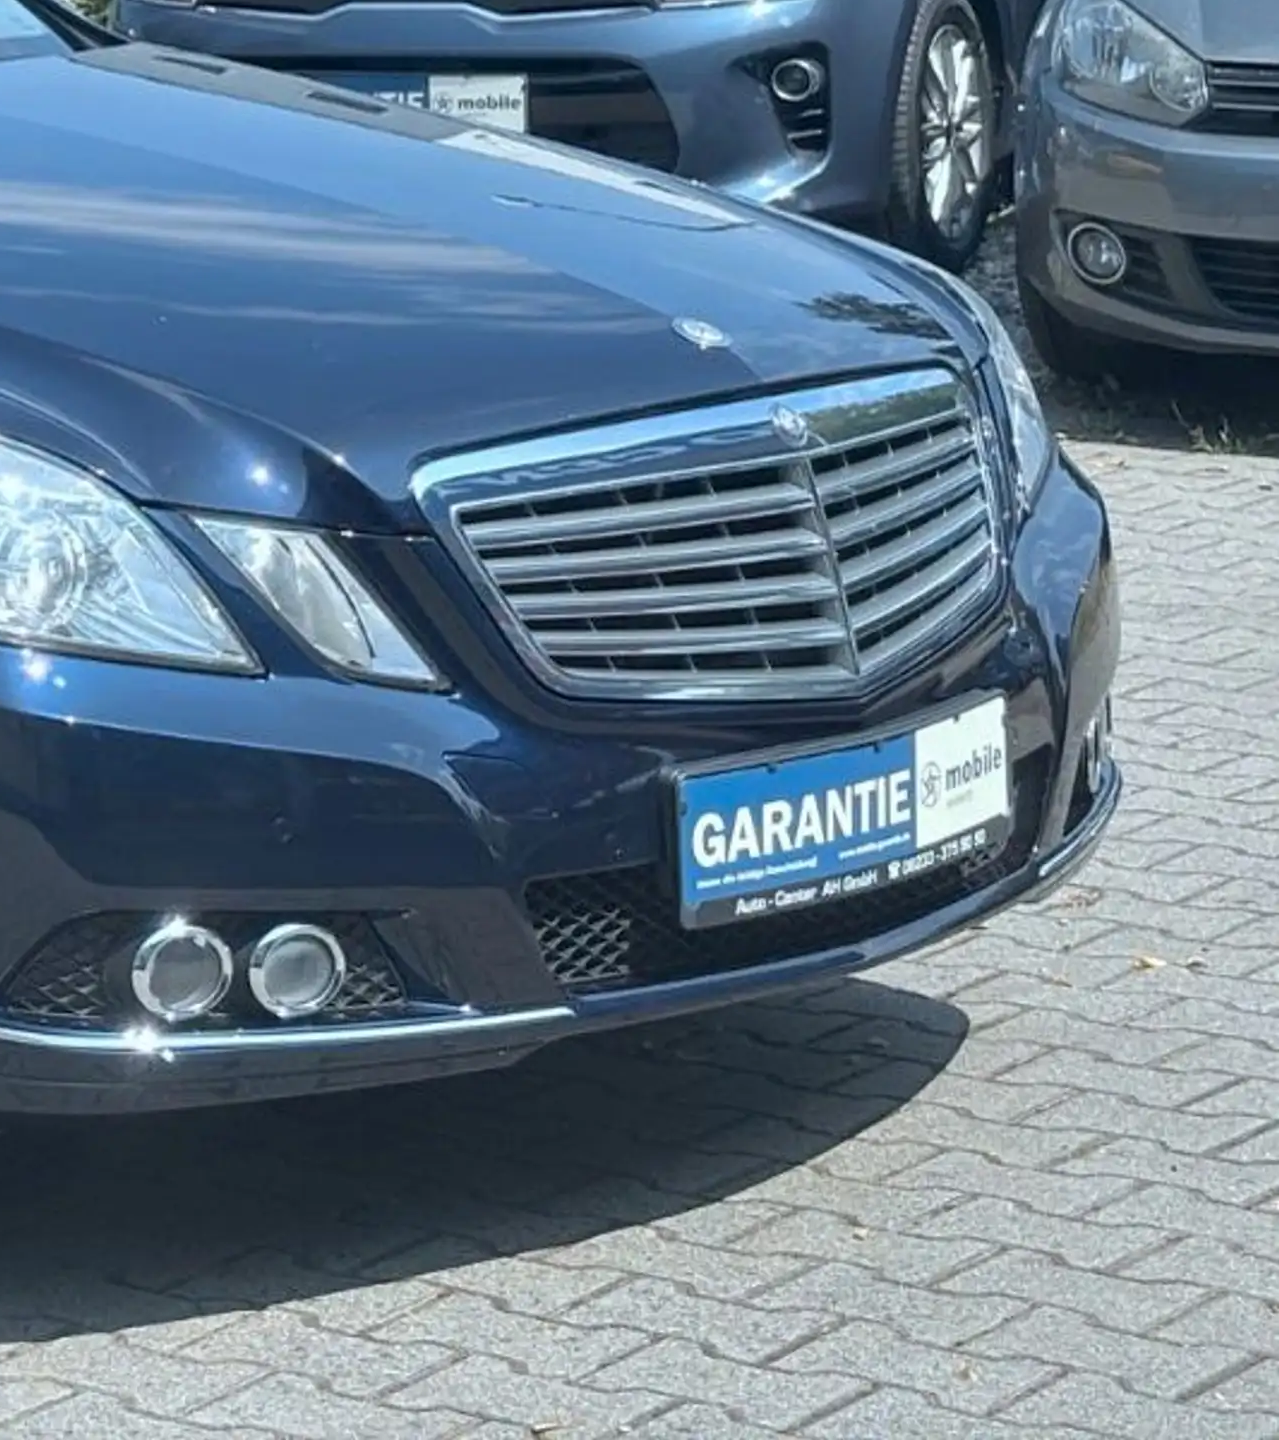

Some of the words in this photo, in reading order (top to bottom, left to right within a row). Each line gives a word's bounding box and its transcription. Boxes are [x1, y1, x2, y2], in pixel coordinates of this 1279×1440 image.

[458, 91, 523, 111] mobile
[945, 742, 1002, 792] mobile
[693, 768, 911, 868] GARANTIE
